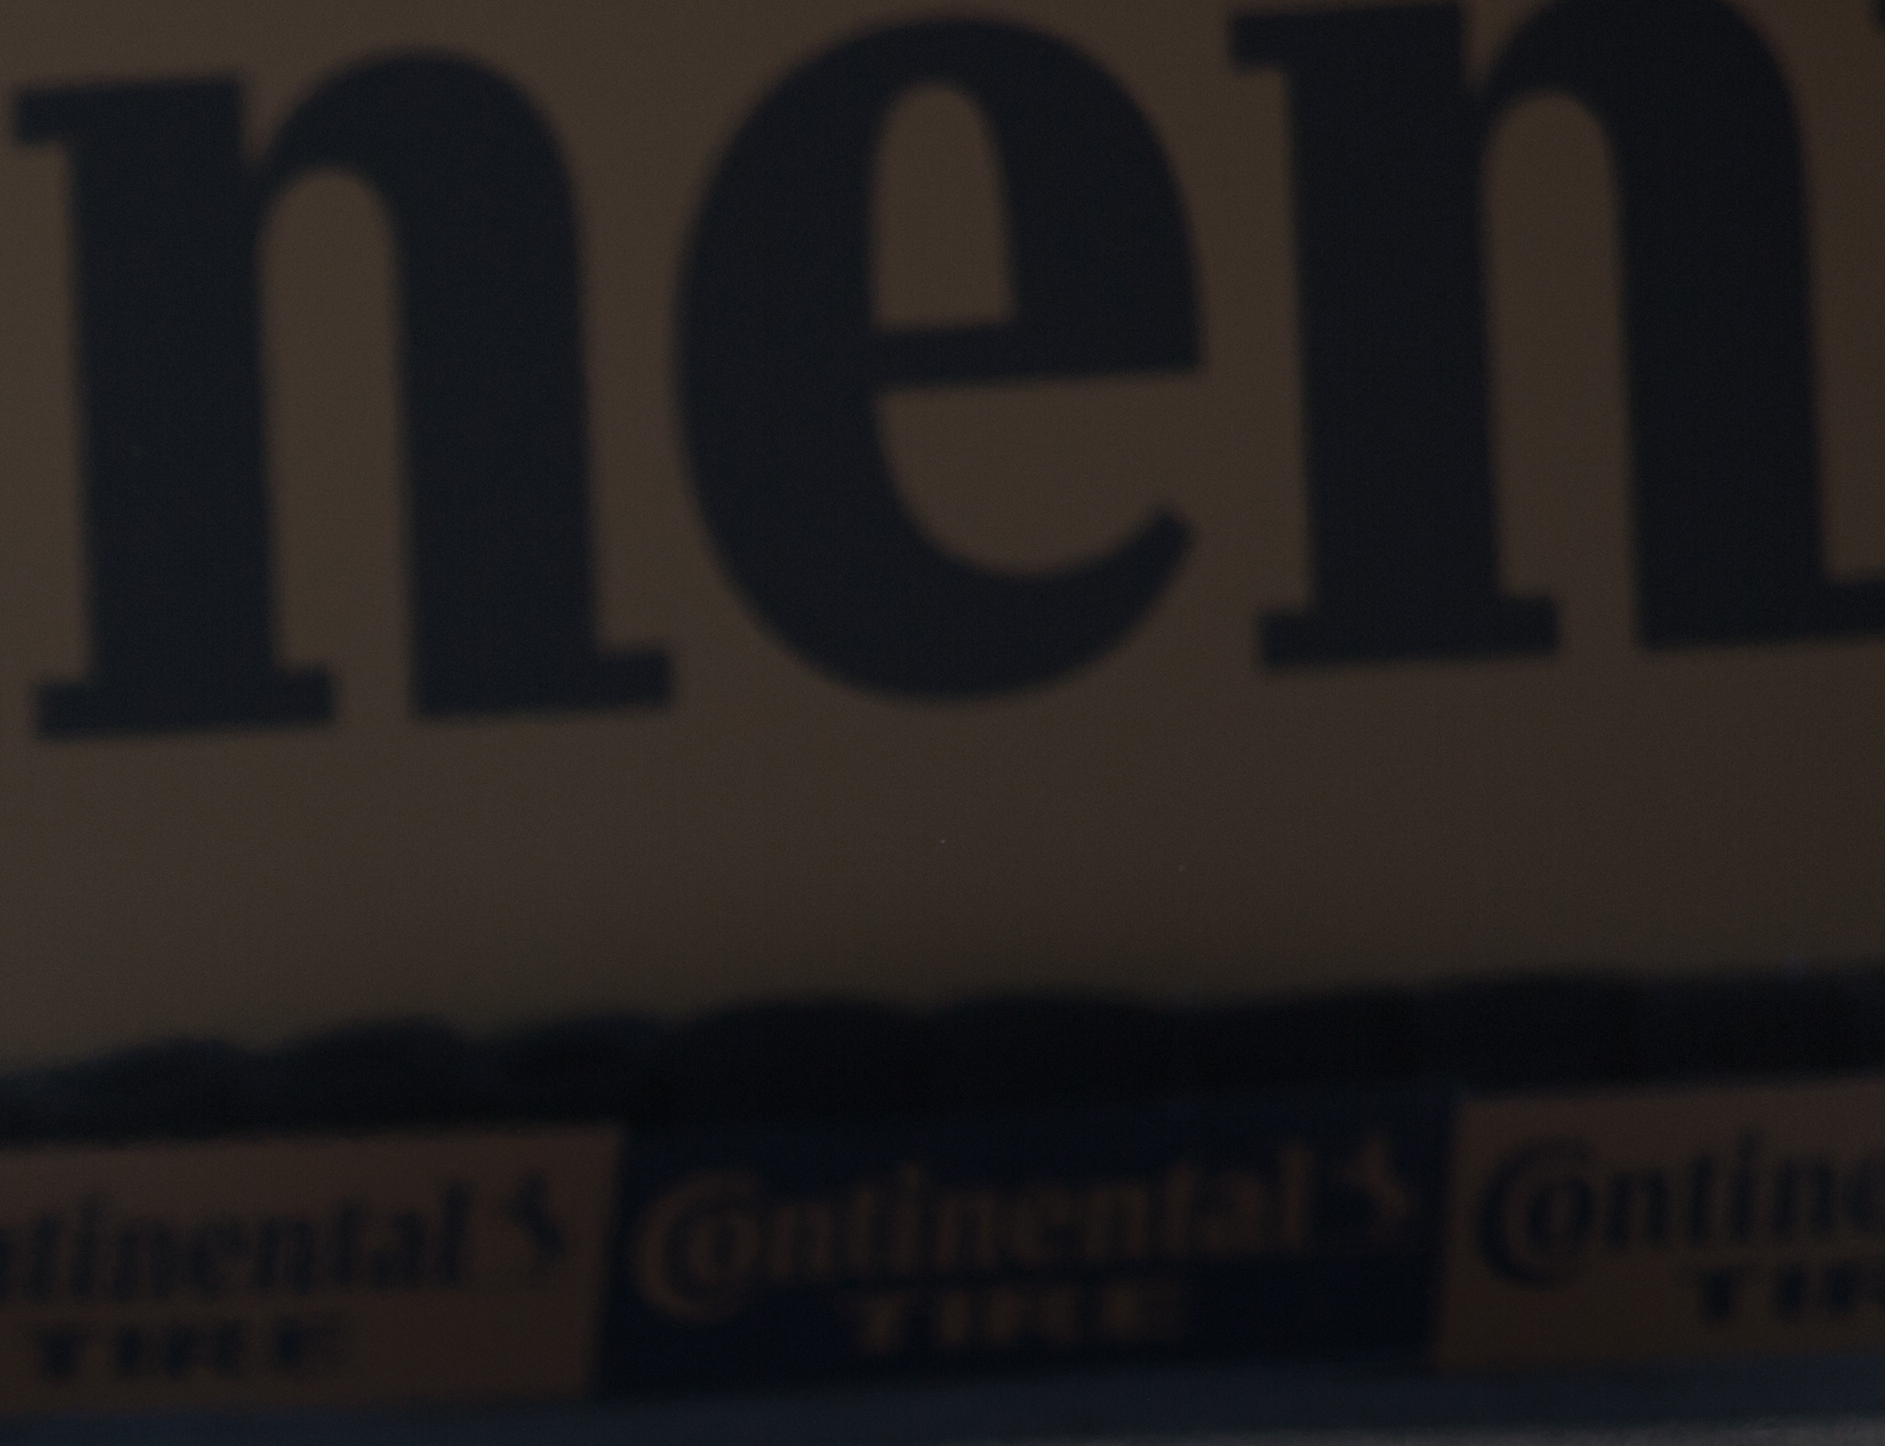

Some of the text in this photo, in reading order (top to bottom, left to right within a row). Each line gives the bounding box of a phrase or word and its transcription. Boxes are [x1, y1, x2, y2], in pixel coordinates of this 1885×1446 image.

[634, 1139, 1316, 1326] Continental
[39, 1317, 342, 1382] TIRE
[844, 1278, 1194, 1356] TIRE
